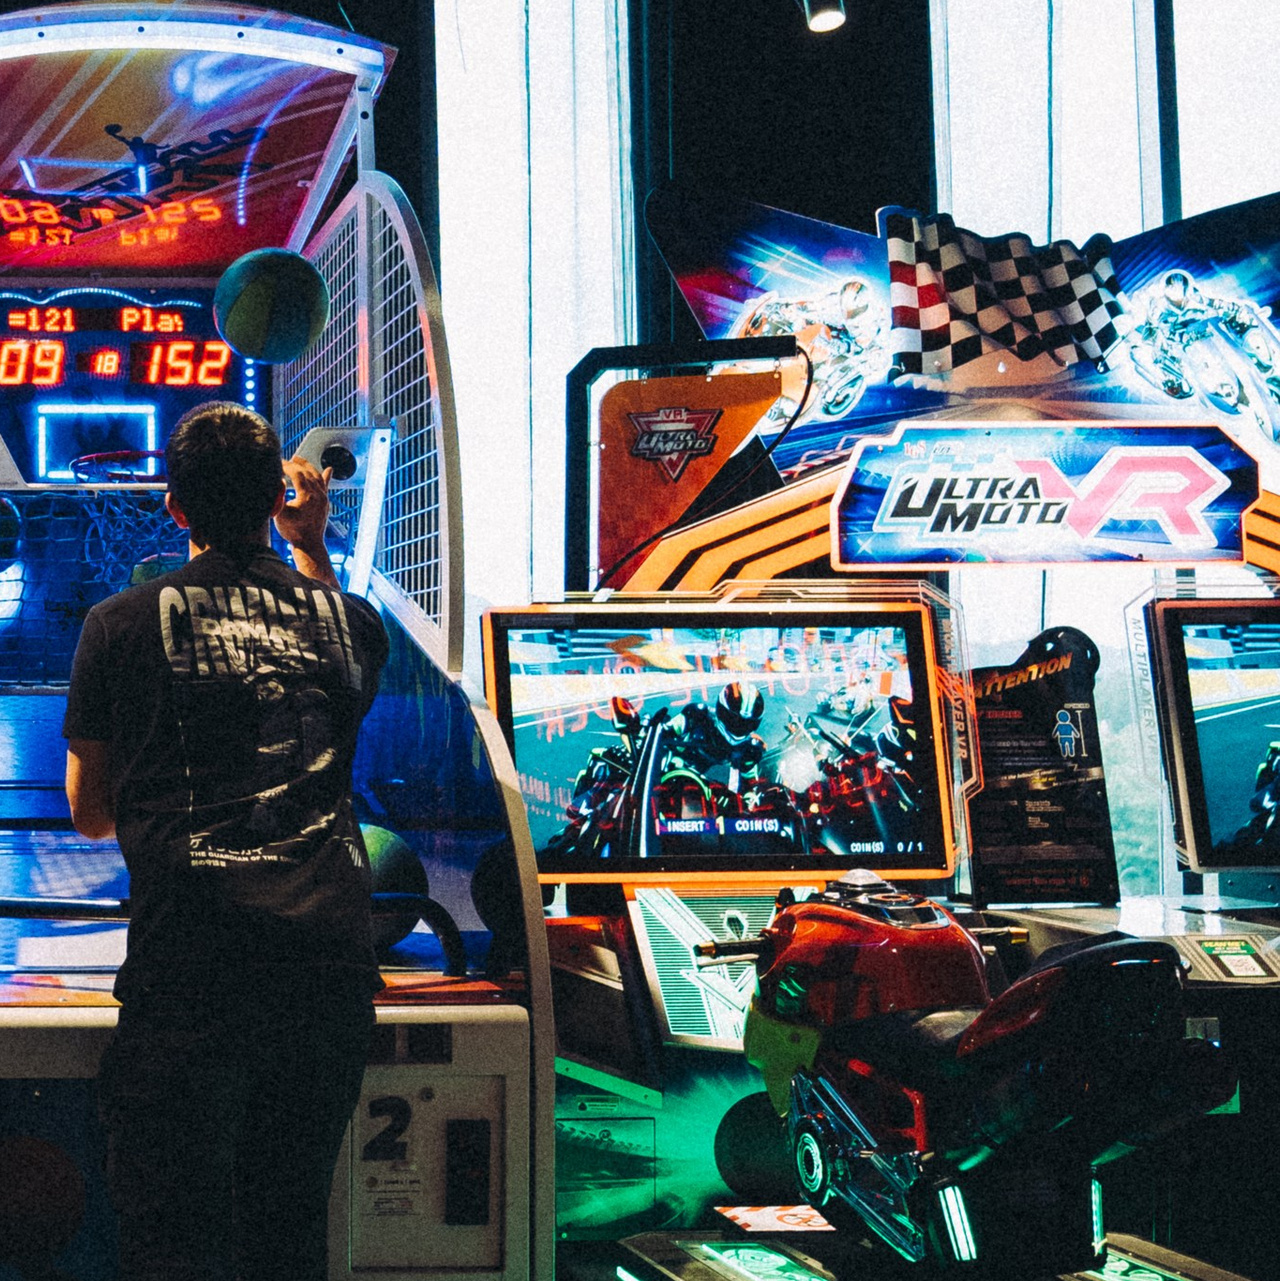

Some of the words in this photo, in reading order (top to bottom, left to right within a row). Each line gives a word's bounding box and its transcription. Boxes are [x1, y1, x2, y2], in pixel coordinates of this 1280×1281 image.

[93, 352, 119, 375] 18
[147, 340, 231, 386] 152
[638, 431, 697, 450] ULTRA
[654, 439, 706, 453] MOTO
[890, 476, 1041, 518] ULTRA
[1014, 456, 1218, 539] VR
[929, 501, 1069, 533] MOTO
[974, 652, 1073, 698] ATTENTION
[667, 820, 705, 832] INSERT
[715, 816, 725, 835] 1
[735, 819, 779, 833] COIN(S)
[208, 852, 249, 862] GUARDIAN
[850, 841, 885, 853] COIN(S)
[362, 1095, 412, 1161] 2
